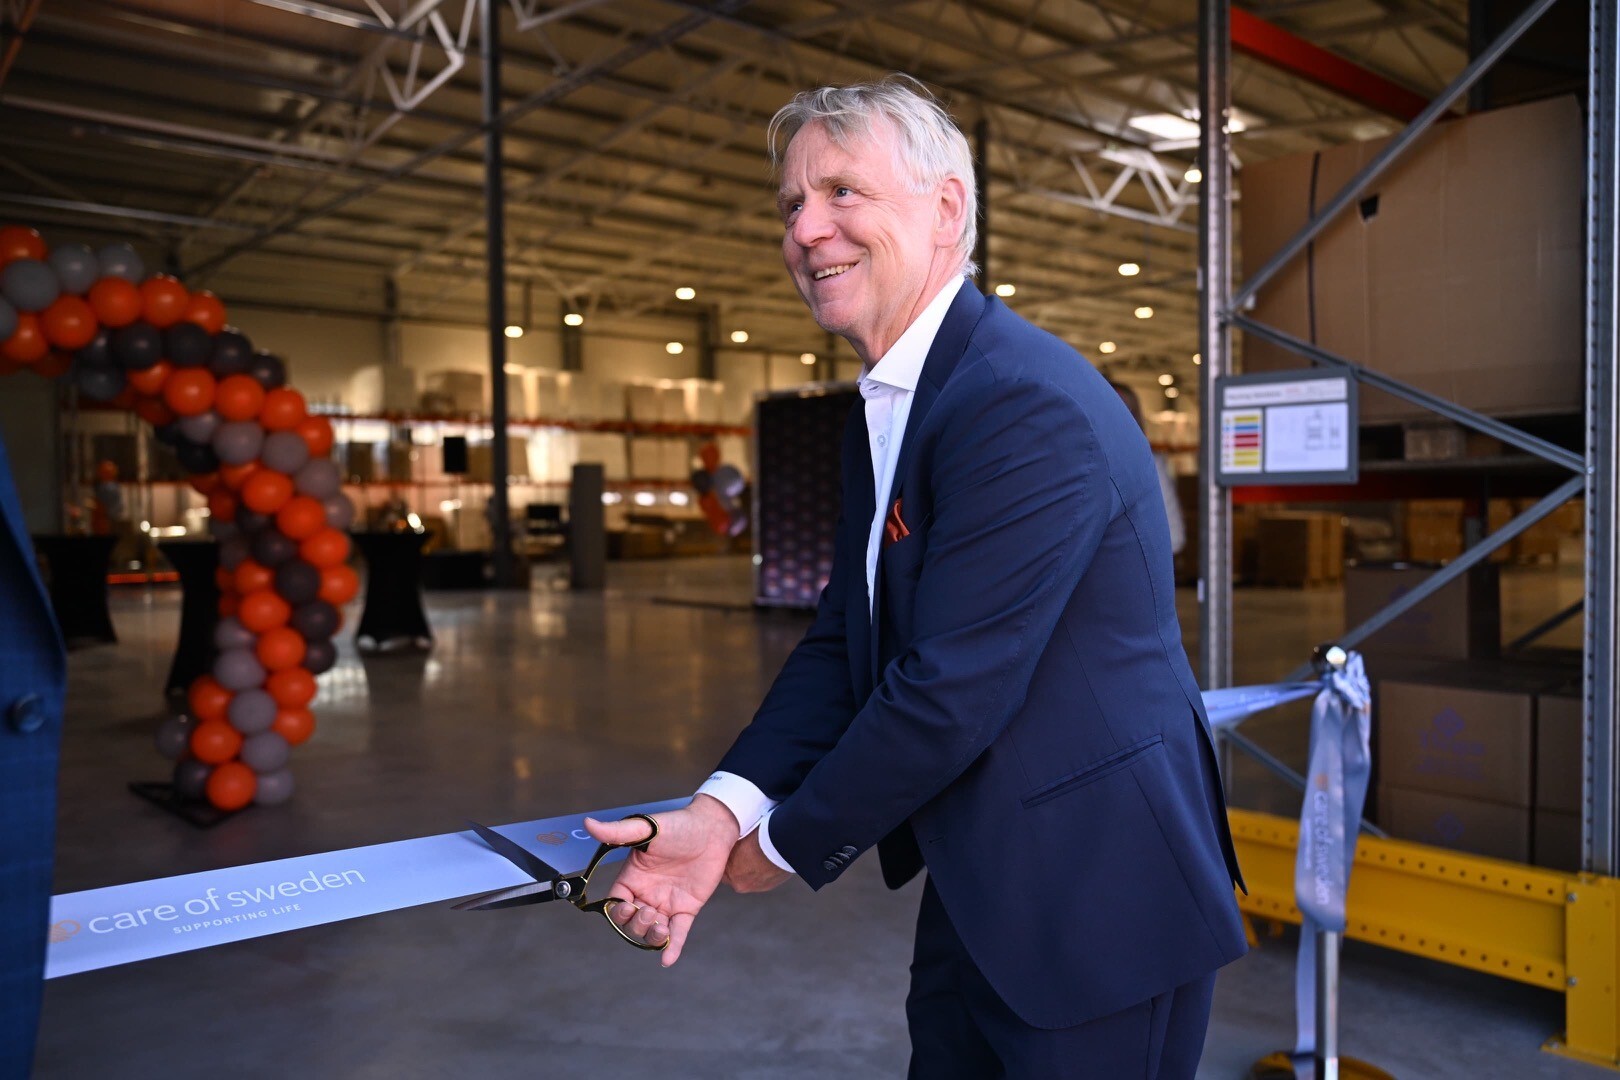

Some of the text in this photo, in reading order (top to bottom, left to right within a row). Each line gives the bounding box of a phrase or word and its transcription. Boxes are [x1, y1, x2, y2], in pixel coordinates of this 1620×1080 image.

[88, 869, 366, 934] care of sweden
[173, 903, 301, 934] SUPPORTING LIFE
